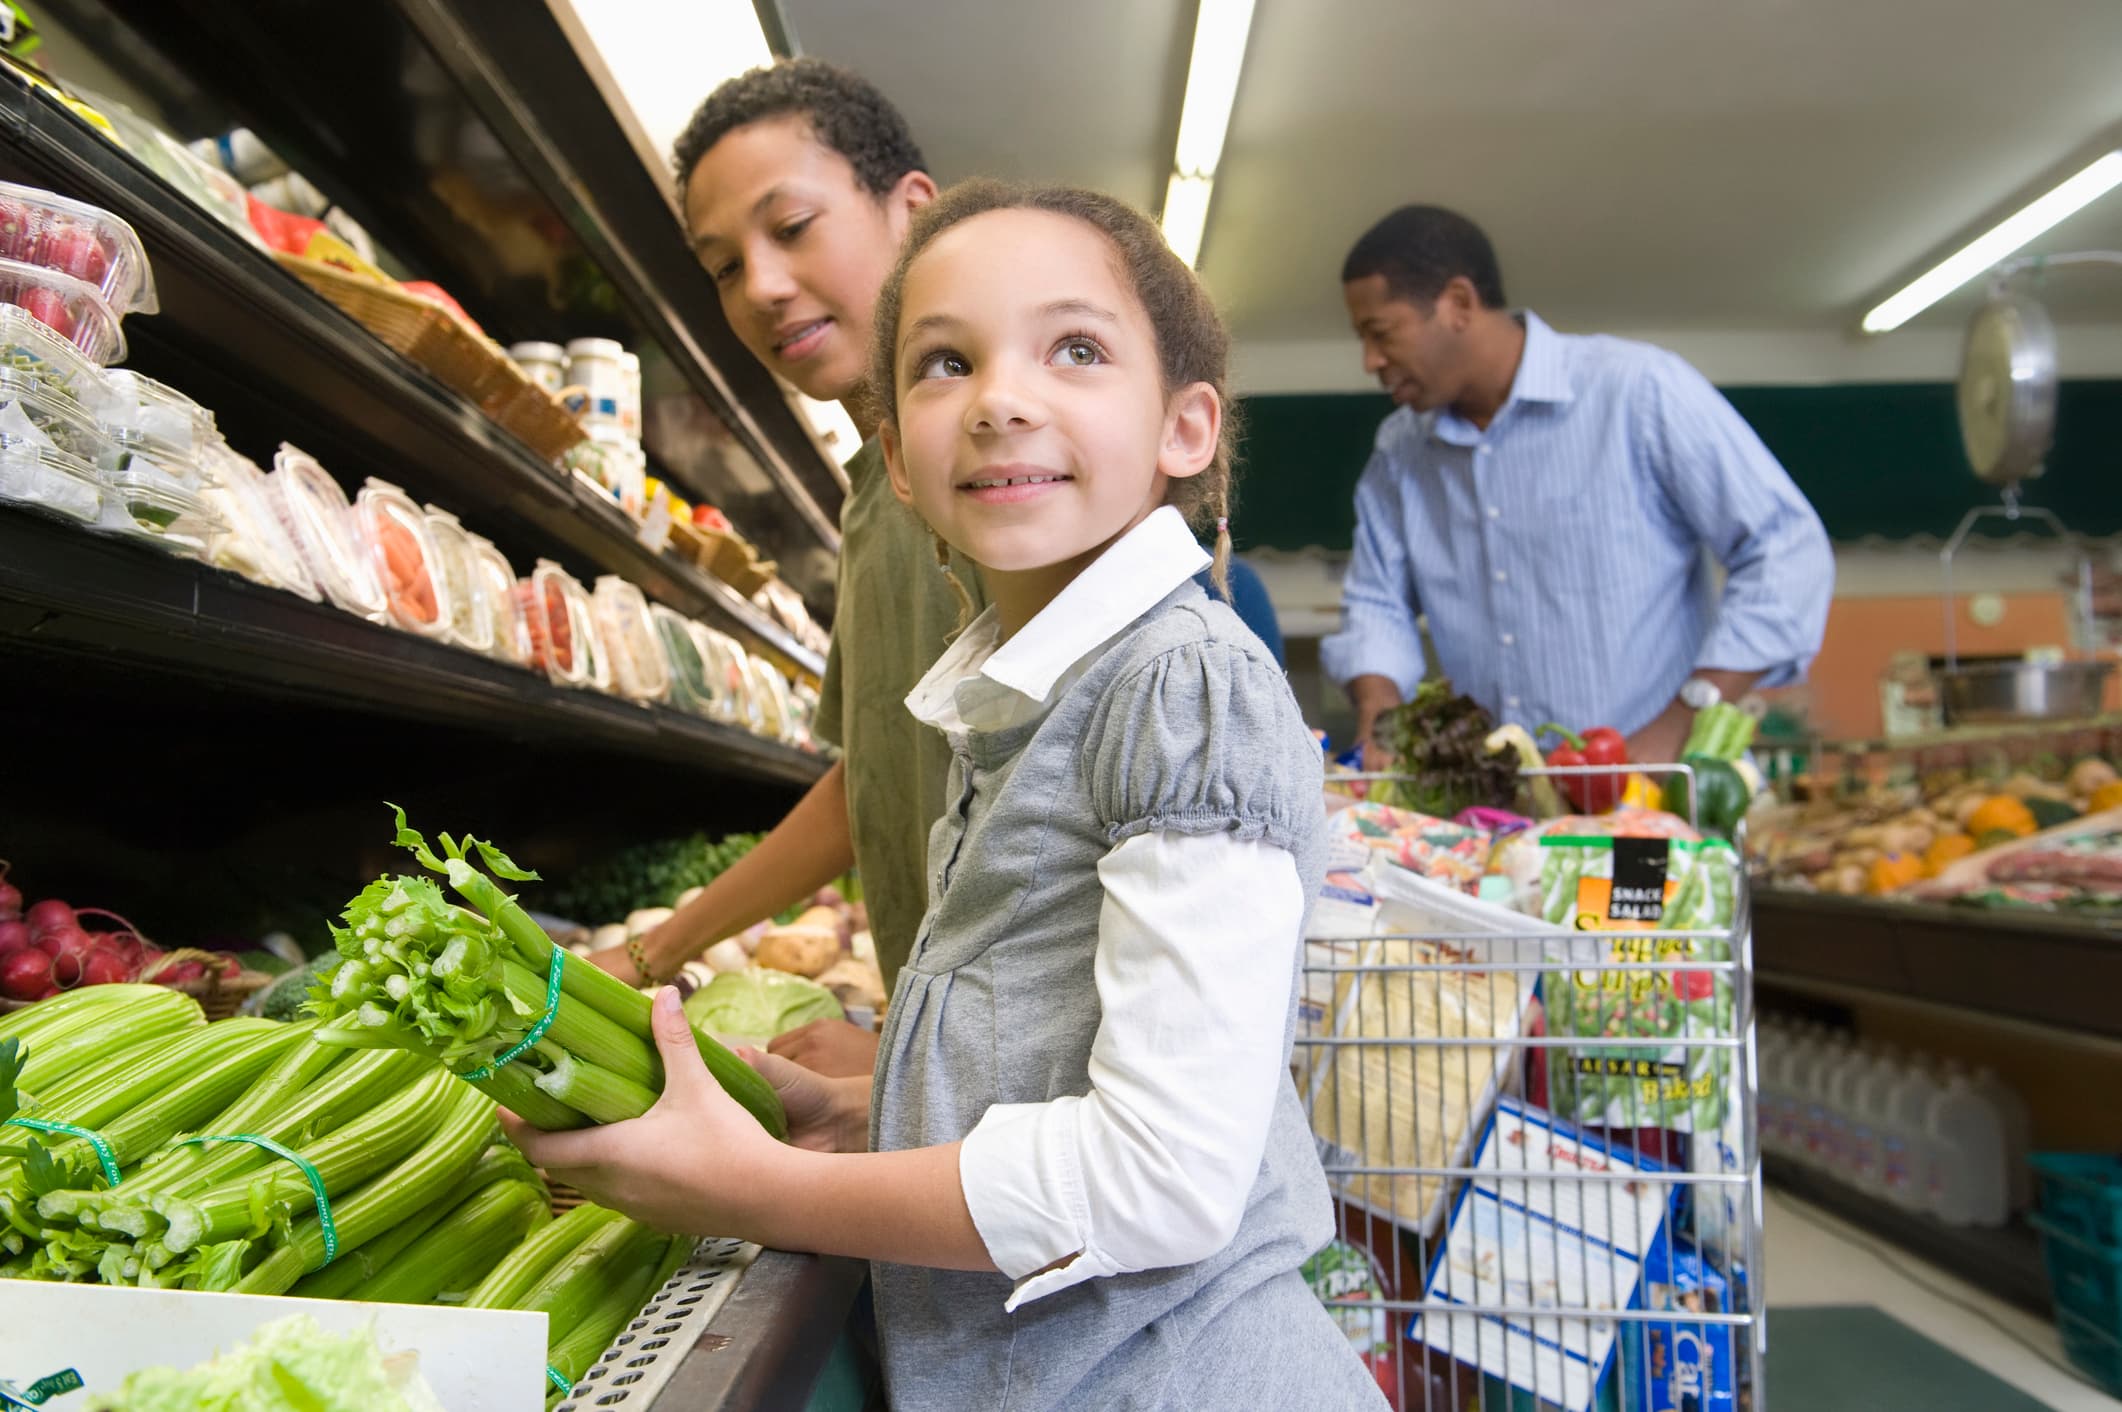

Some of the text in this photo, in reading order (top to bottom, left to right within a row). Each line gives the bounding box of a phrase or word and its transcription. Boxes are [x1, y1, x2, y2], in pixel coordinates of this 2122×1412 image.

[1612, 886, 1662, 902] SNACK
[1610, 903, 1662, 919] SALAD
[108, 1162, 120, 1184] Foo
